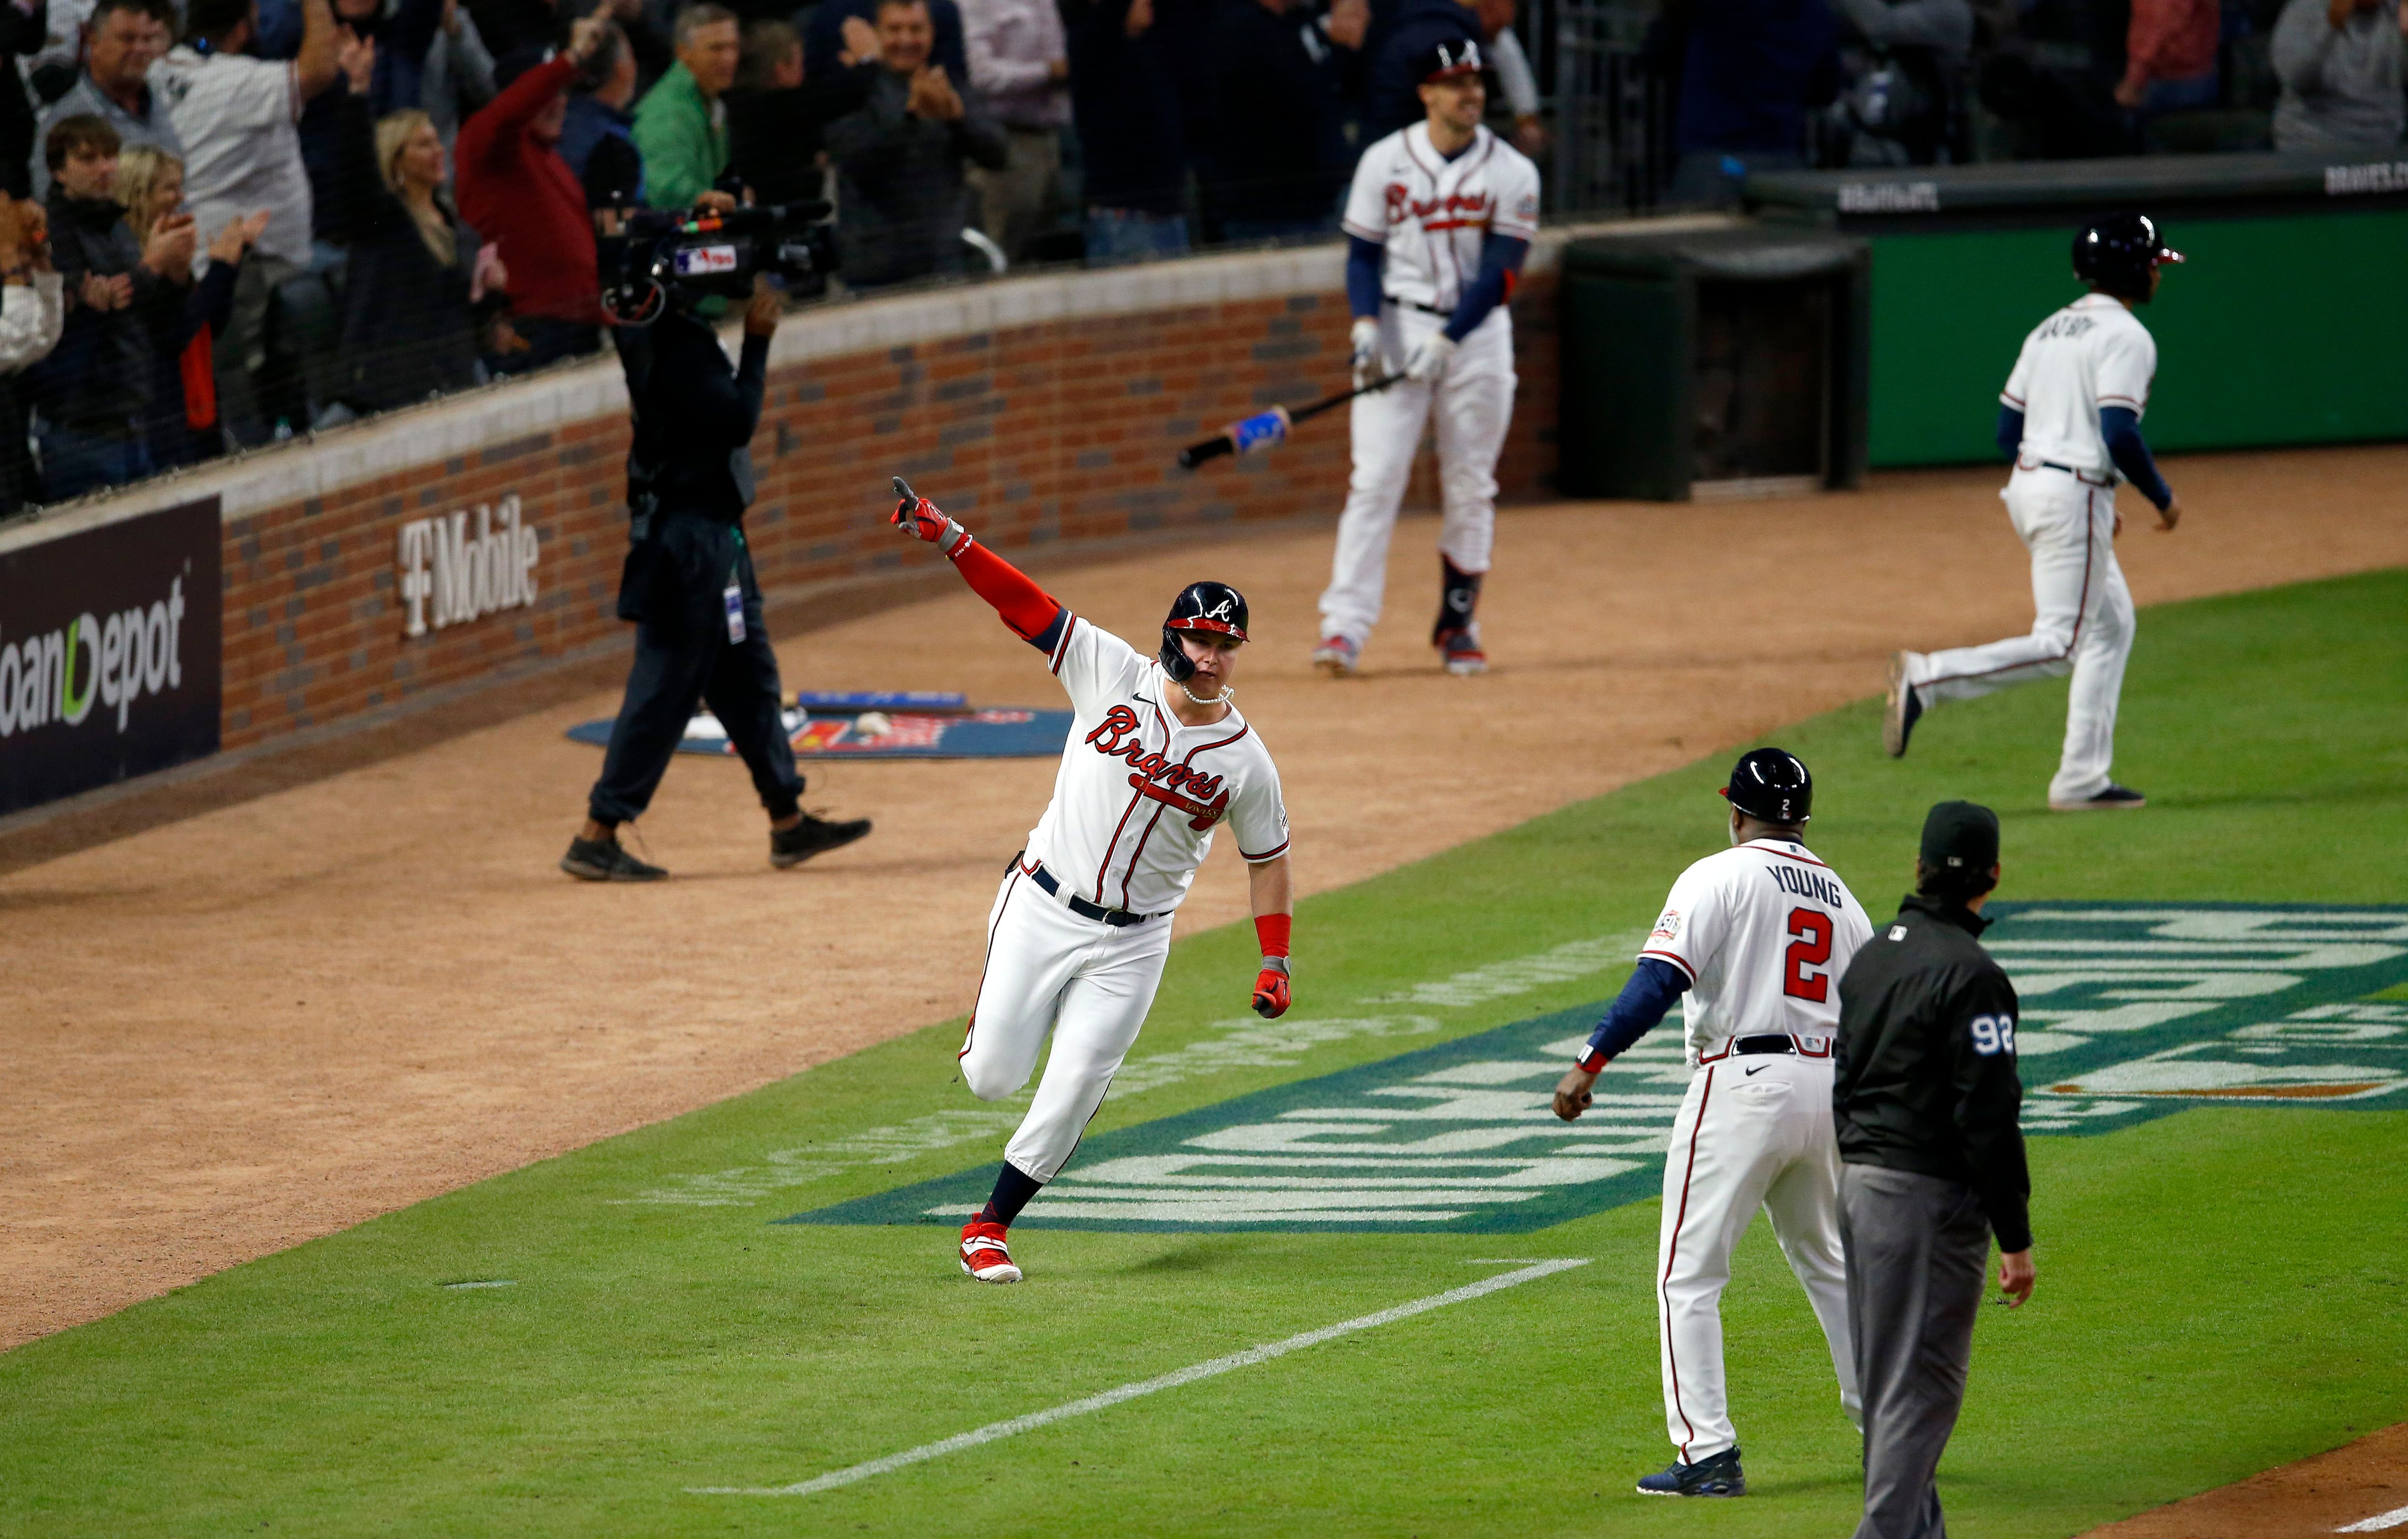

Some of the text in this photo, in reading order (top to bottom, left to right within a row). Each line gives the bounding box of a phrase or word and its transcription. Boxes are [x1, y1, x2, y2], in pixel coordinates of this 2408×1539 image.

[1385, 182, 1488, 225] Braves
[0, 575, 185, 738] oanDepot
[1085, 704, 1224, 800] Braves
[1782, 799, 1790, 810] 2
[1766, 865, 1842, 909] YOUNG
[1783, 906, 1833, 1004] 2
[1969, 1013, 2014, 1055] 92
